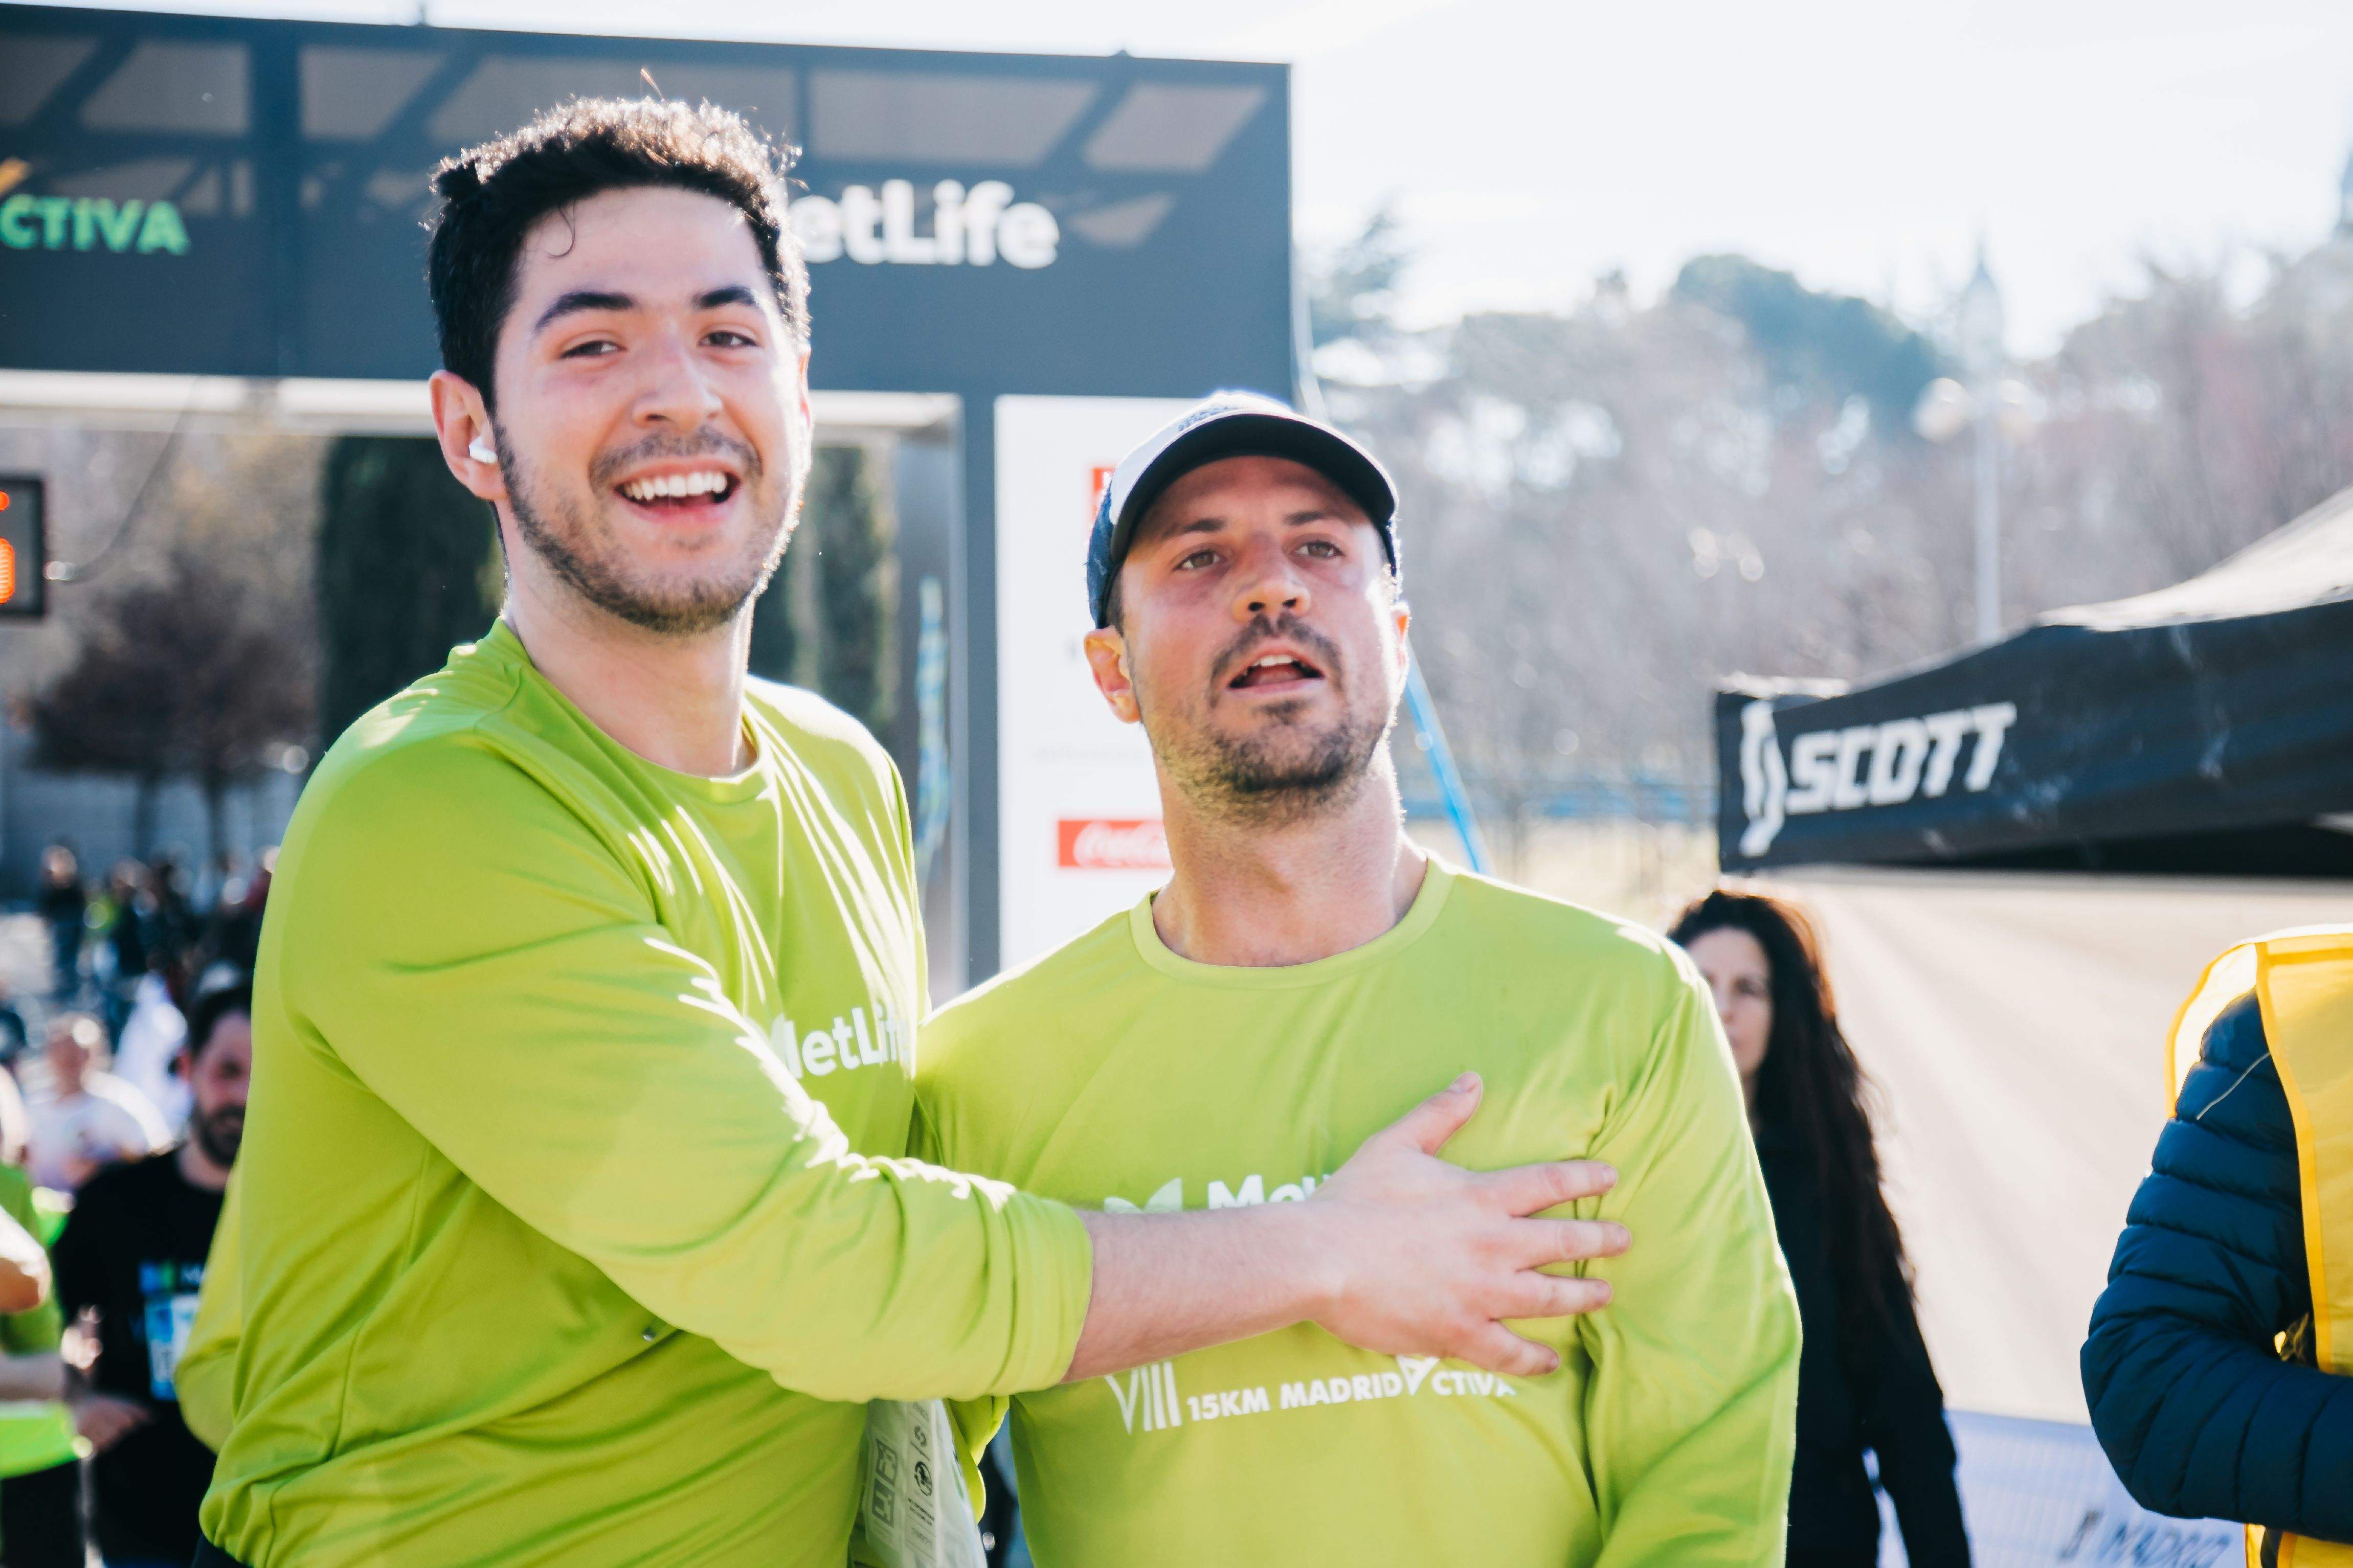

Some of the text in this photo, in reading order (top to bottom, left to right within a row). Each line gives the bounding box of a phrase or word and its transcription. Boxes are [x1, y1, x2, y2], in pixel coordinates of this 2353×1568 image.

[771, 179, 1060, 269] etLife
[1785, 701, 2017, 816] SCOTT
[1187, 1386, 1271, 1421] 15KM
